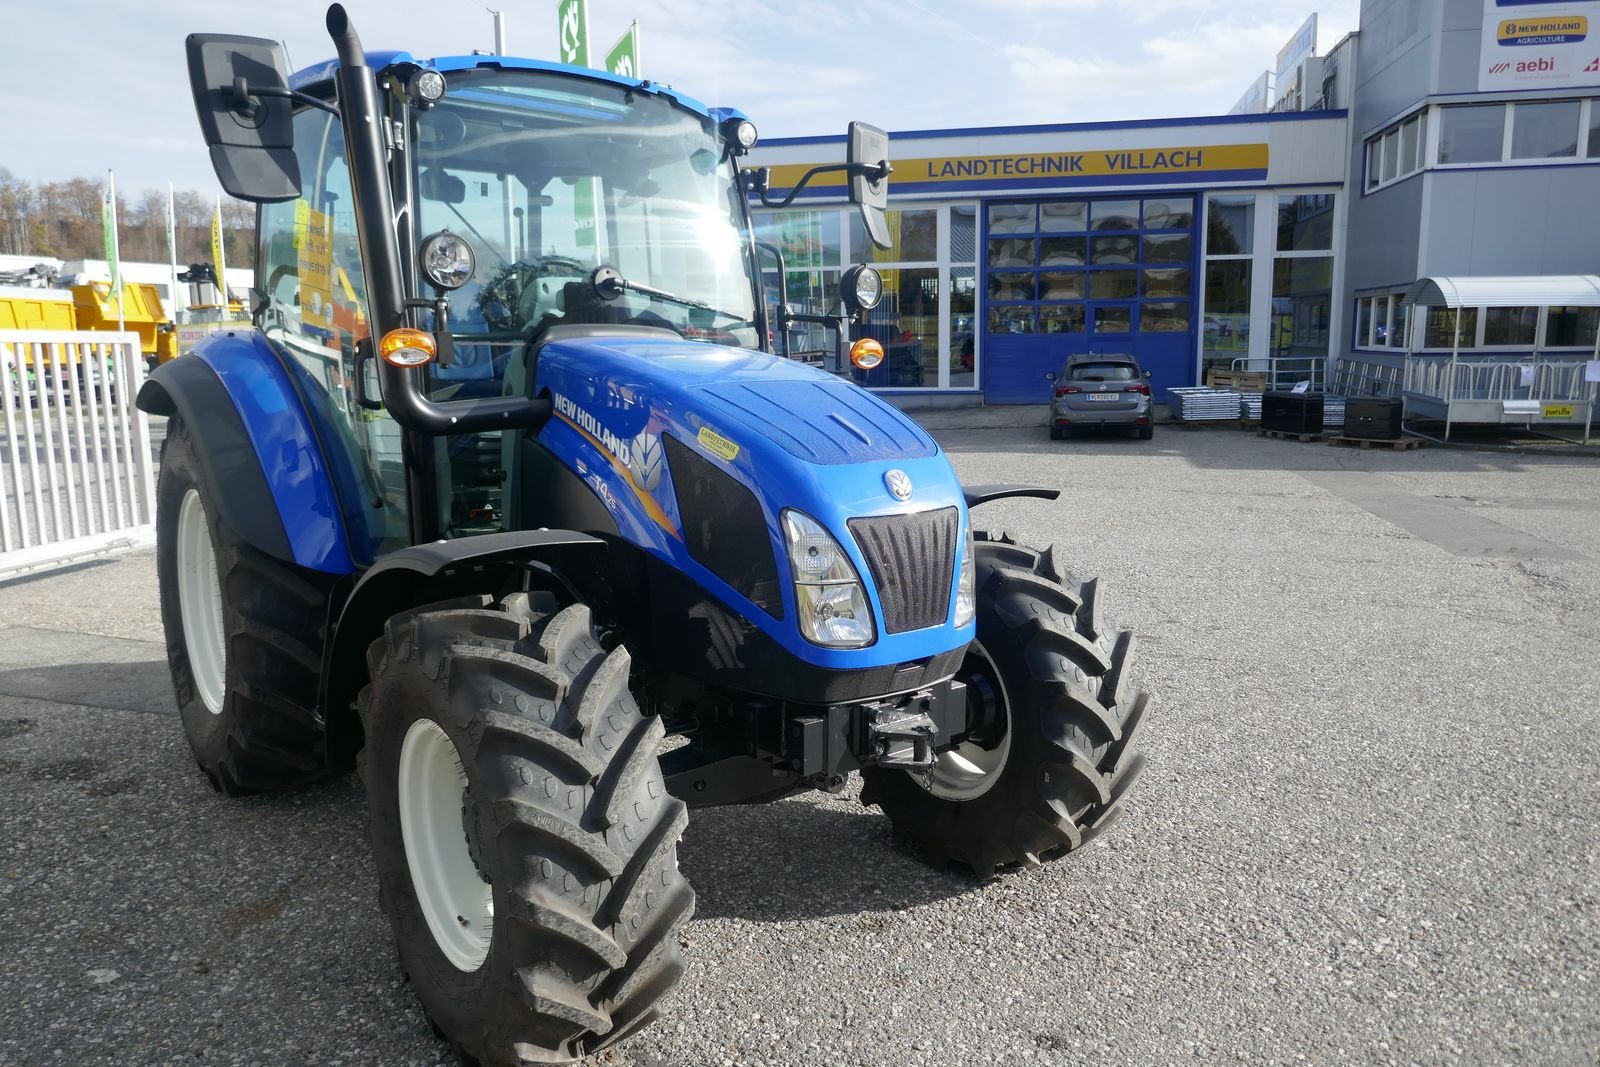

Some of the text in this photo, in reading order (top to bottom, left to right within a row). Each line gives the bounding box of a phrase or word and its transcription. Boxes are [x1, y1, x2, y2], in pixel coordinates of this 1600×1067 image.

[1518, 22, 1581, 33] NEW HOLLAND
[1517, 35, 1566, 44] AGRICULTURE
[1516, 57, 1555, 73] aebi
[927, 150, 1203, 178] LANDTECHNIK VILLACH
[554, 393, 631, 468] NEW HOLLAND
[700, 427, 737, 454] LANDTECHNIK
